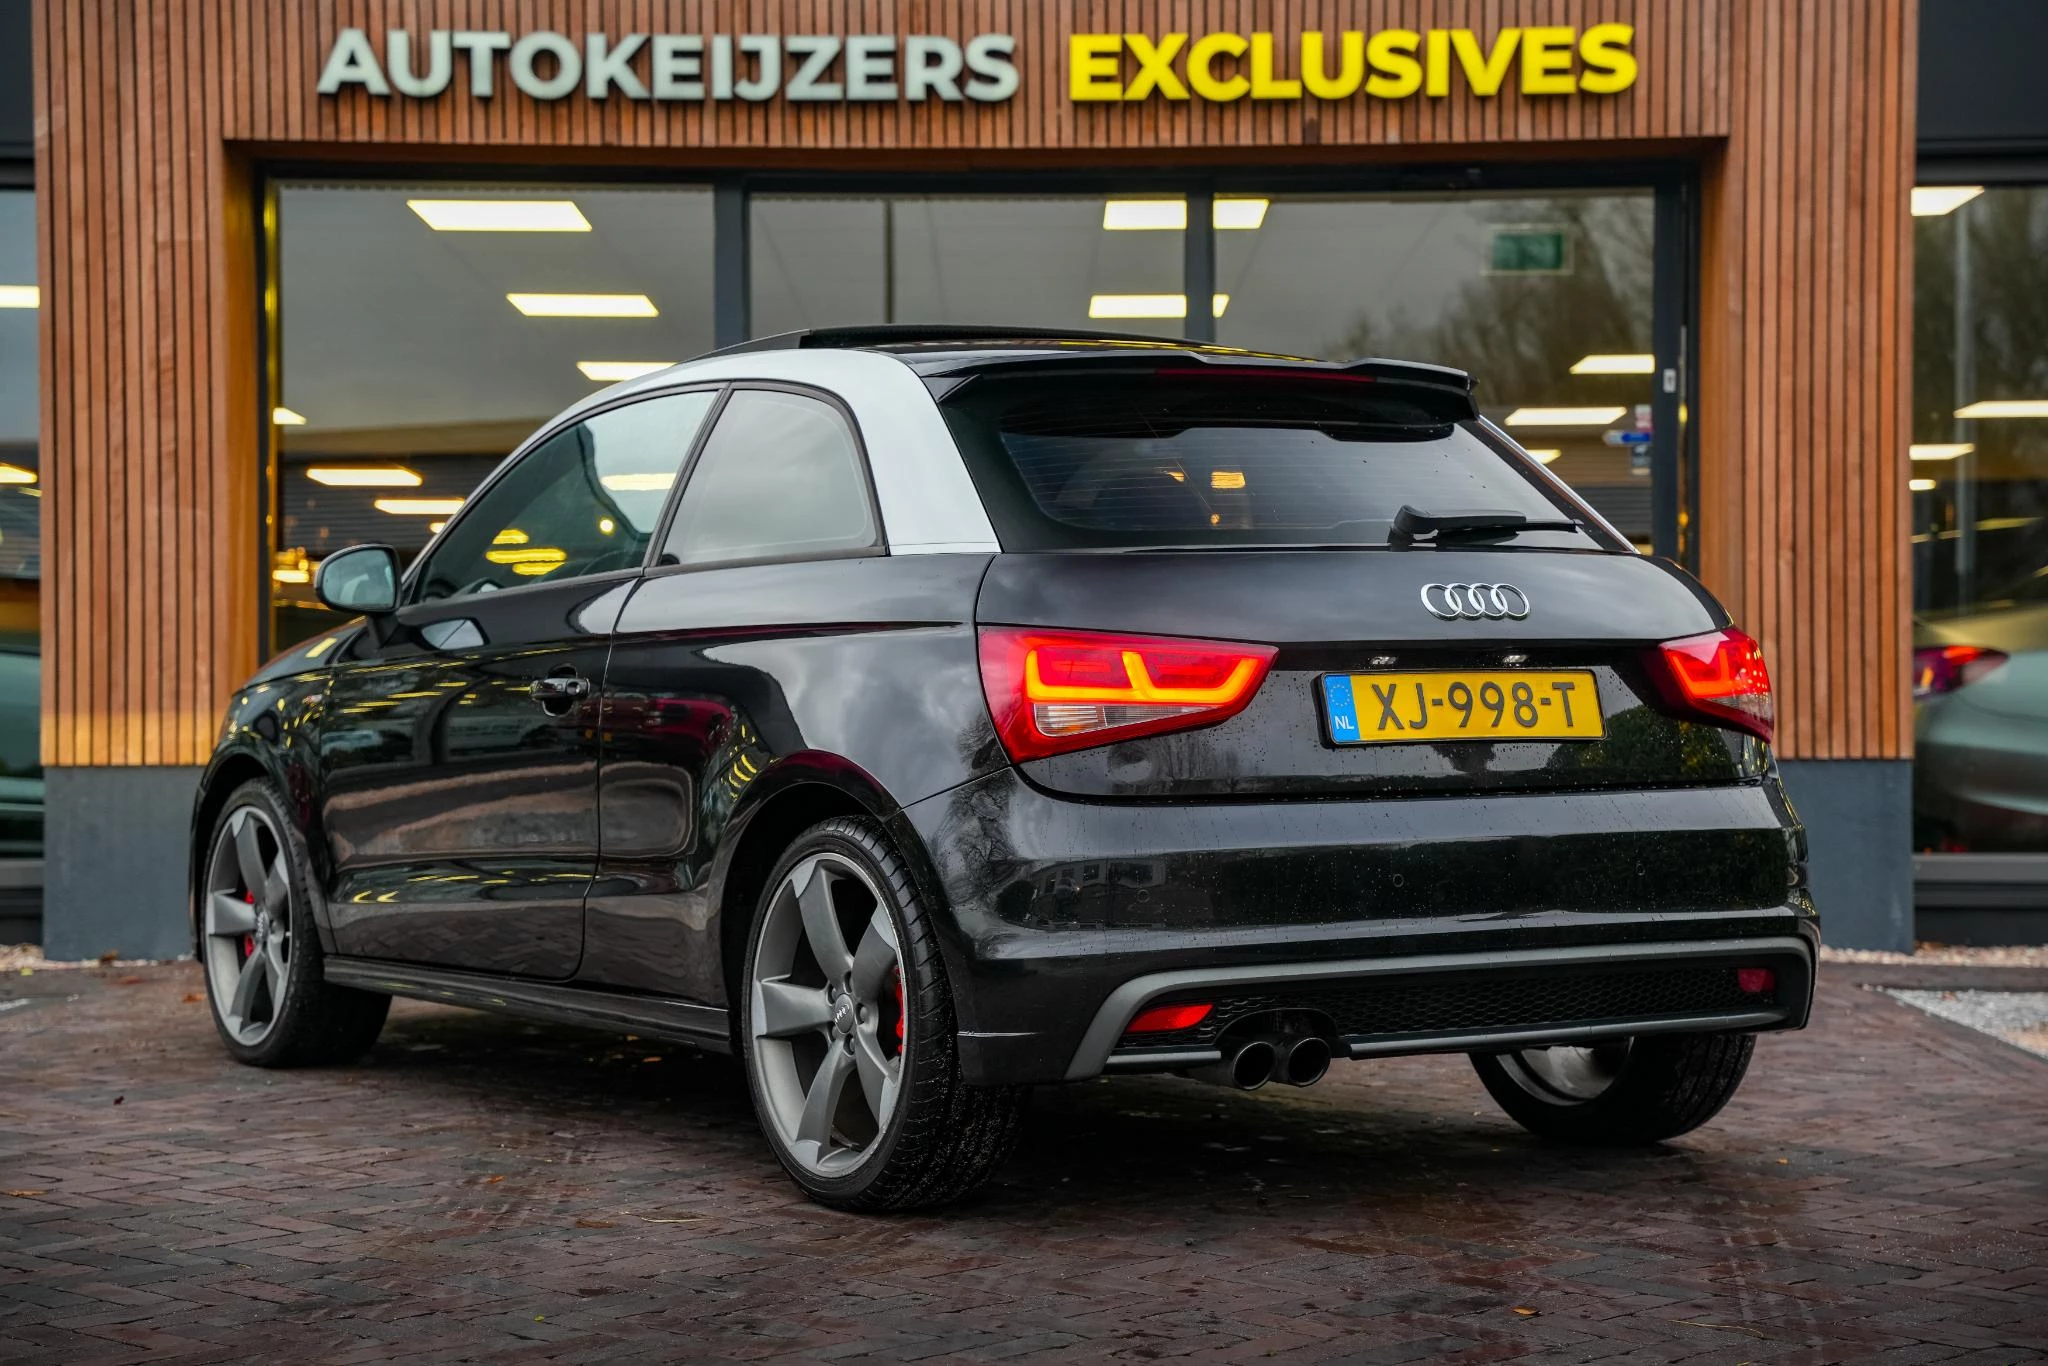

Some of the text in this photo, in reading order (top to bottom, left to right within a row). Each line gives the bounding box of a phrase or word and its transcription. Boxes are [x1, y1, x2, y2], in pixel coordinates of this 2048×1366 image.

[317, 22, 1638, 102] AUTOKEIJZERS EXCLUSIVES
[1335, 715, 1354, 730] NL
[1371, 681, 1575, 730] XJ-998-T
